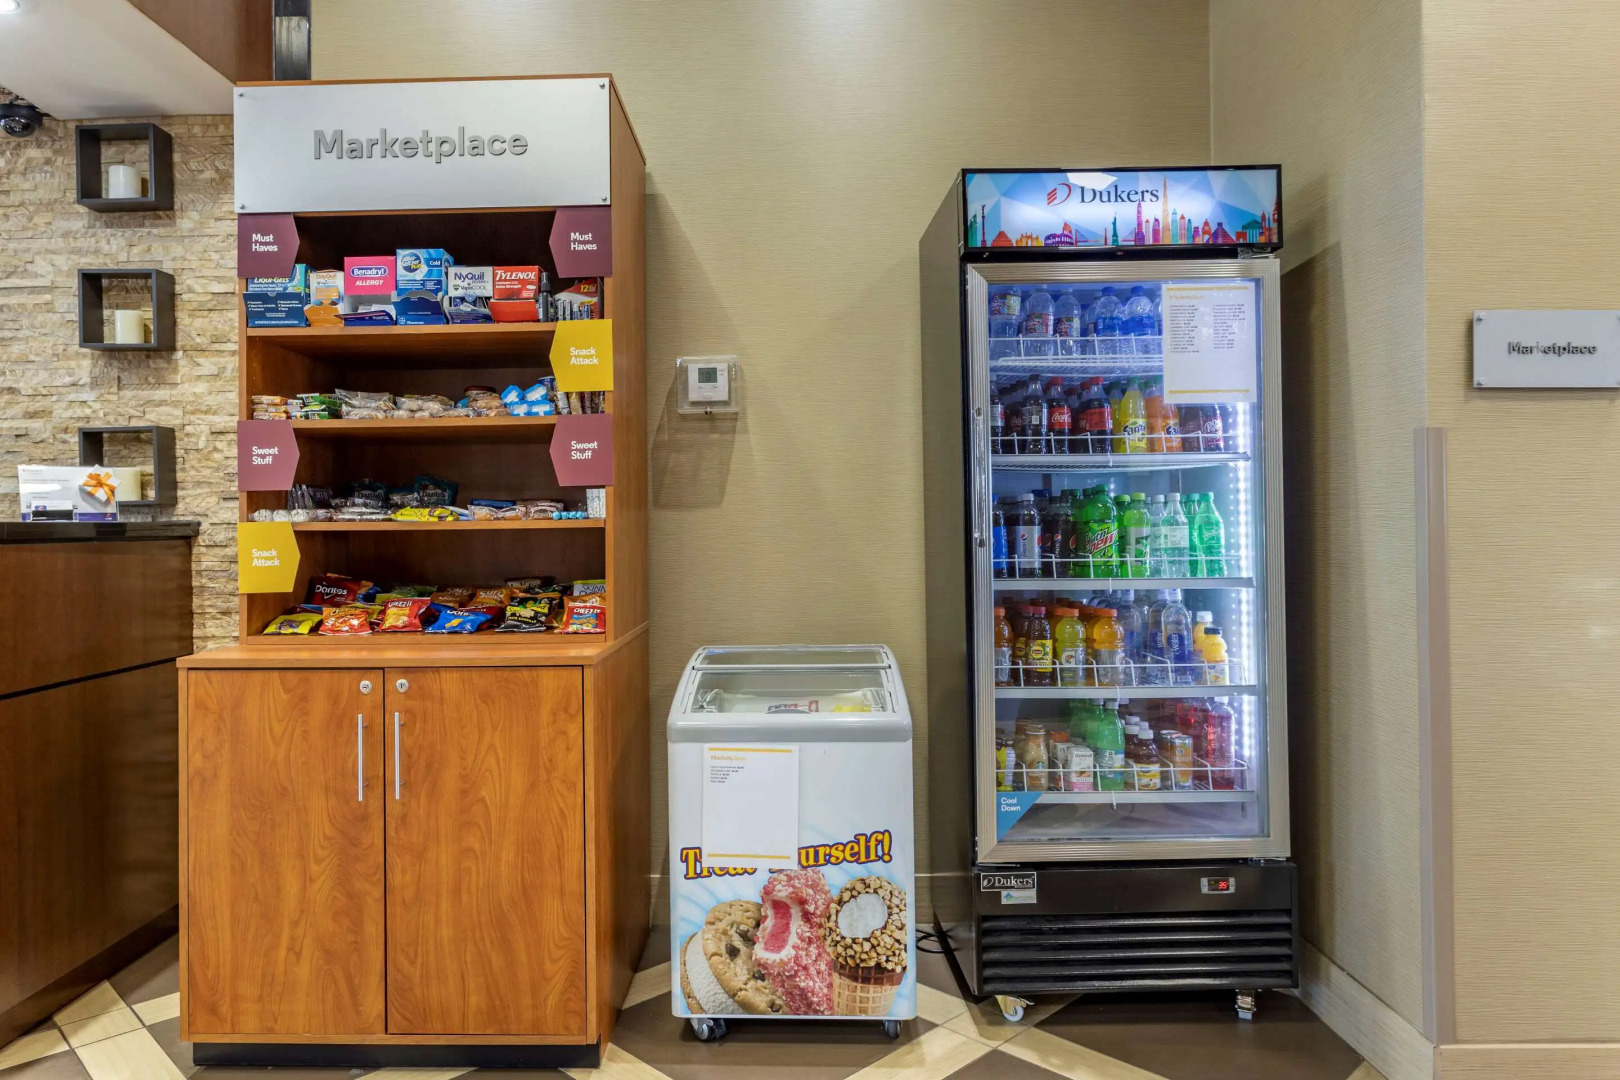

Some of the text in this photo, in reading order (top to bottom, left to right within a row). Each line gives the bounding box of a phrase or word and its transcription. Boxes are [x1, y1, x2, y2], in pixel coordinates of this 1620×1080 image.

[313, 126, 528, 164] Marketplace
[1079, 184, 1159, 203] Dukers
[252, 233, 274, 242] Must
[570, 232, 592, 241] Must
[252, 243, 278, 251] Haves
[570, 242, 597, 251] Haves
[353, 267, 385, 276] Benadryl
[495, 270, 537, 280] TYLENOL
[454, 271, 485, 282] NyQuil
[580, 284, 589, 293] 12
[570, 346, 596, 356] Snack
[1507, 341, 1598, 357] Marketplace
[570, 356, 599, 365] Attack
[571, 440, 598, 449] Sweet
[252, 446, 279, 455] Sweet
[571, 450, 593, 459] Stuff
[252, 456, 273, 465] Stuff
[251, 548, 277, 558] Snack
[252, 558, 280, 567] Attack
[315, 584, 348, 595] Doritos
[1000, 804, 1021, 812] Down
[799, 829, 893, 868] urself!
[994, 875, 1034, 887] Dukers
[1218, 881, 1228, 890] 35
